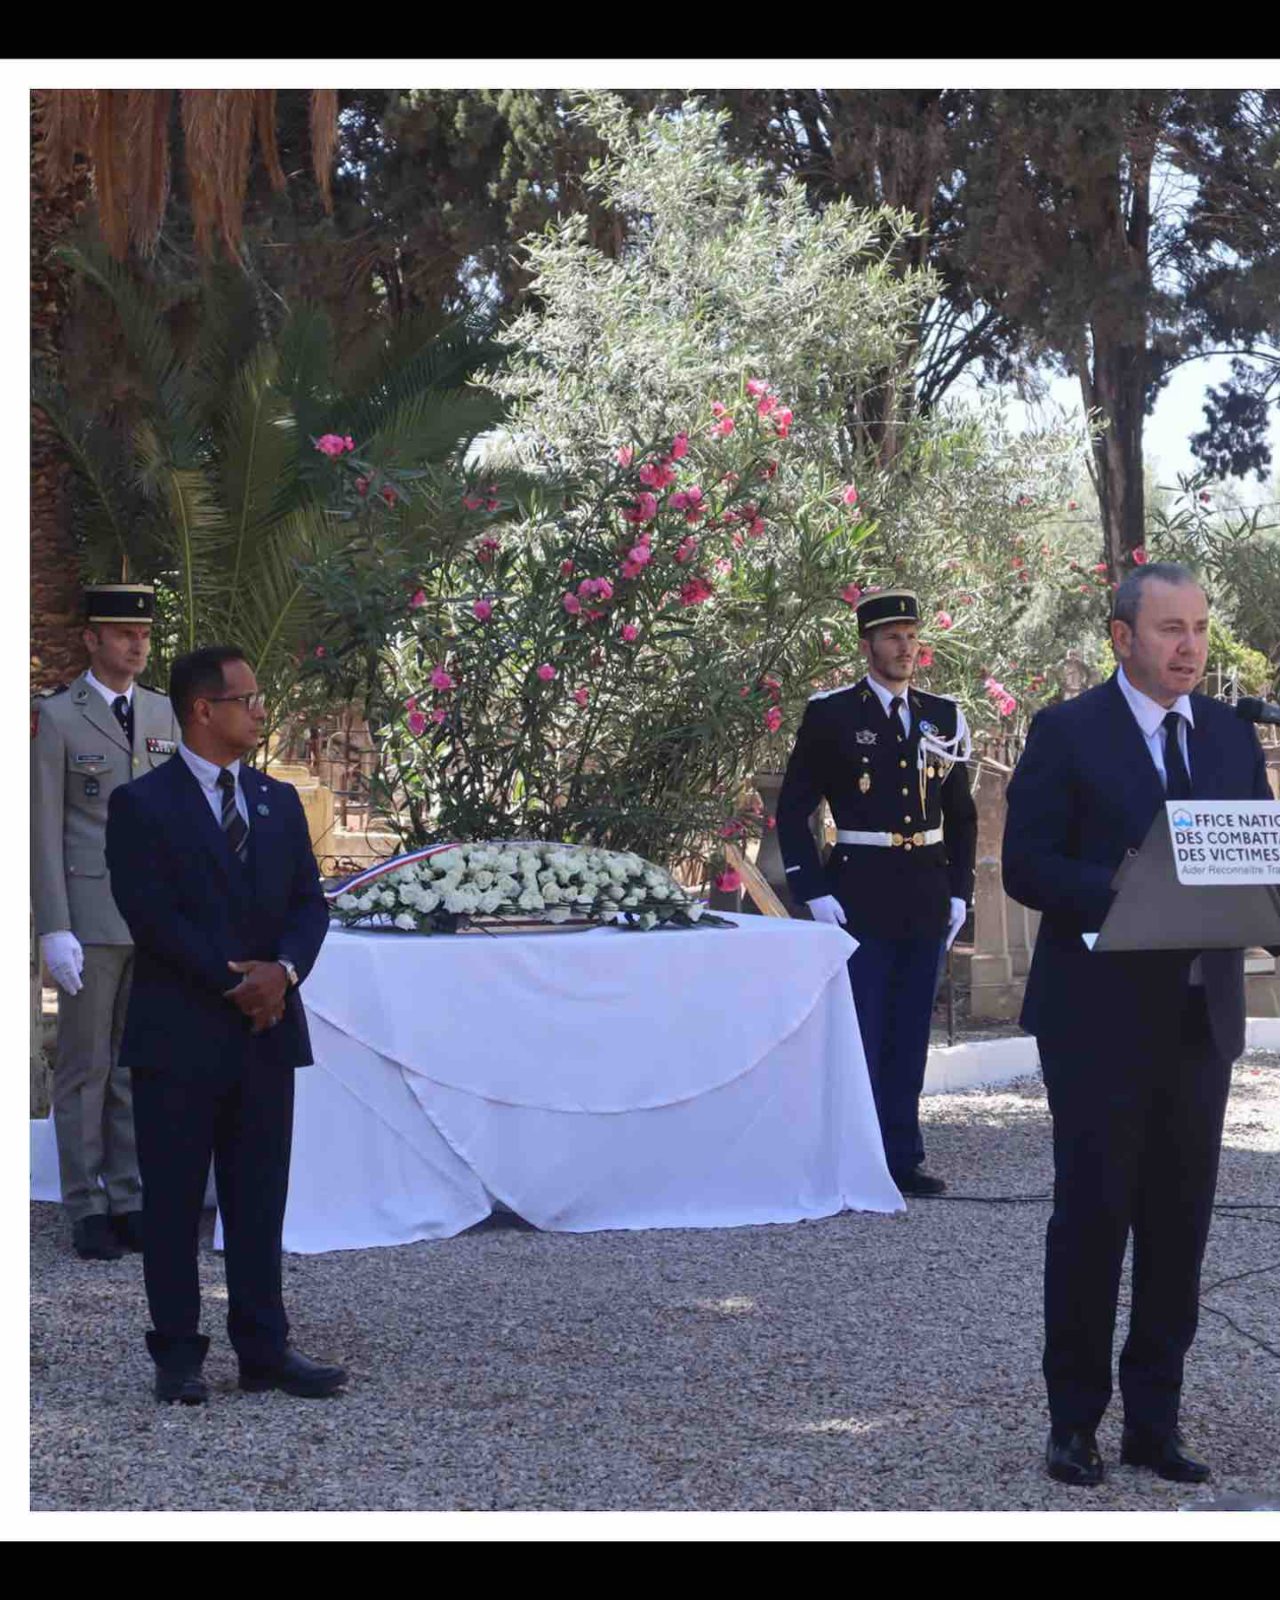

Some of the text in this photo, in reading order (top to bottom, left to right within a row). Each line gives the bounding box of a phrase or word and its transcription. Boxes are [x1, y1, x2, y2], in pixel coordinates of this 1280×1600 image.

[1175, 831, 1203, 844] DES
[1178, 848, 1206, 861] DES
[1209, 848, 1280, 861] VICTIMES
